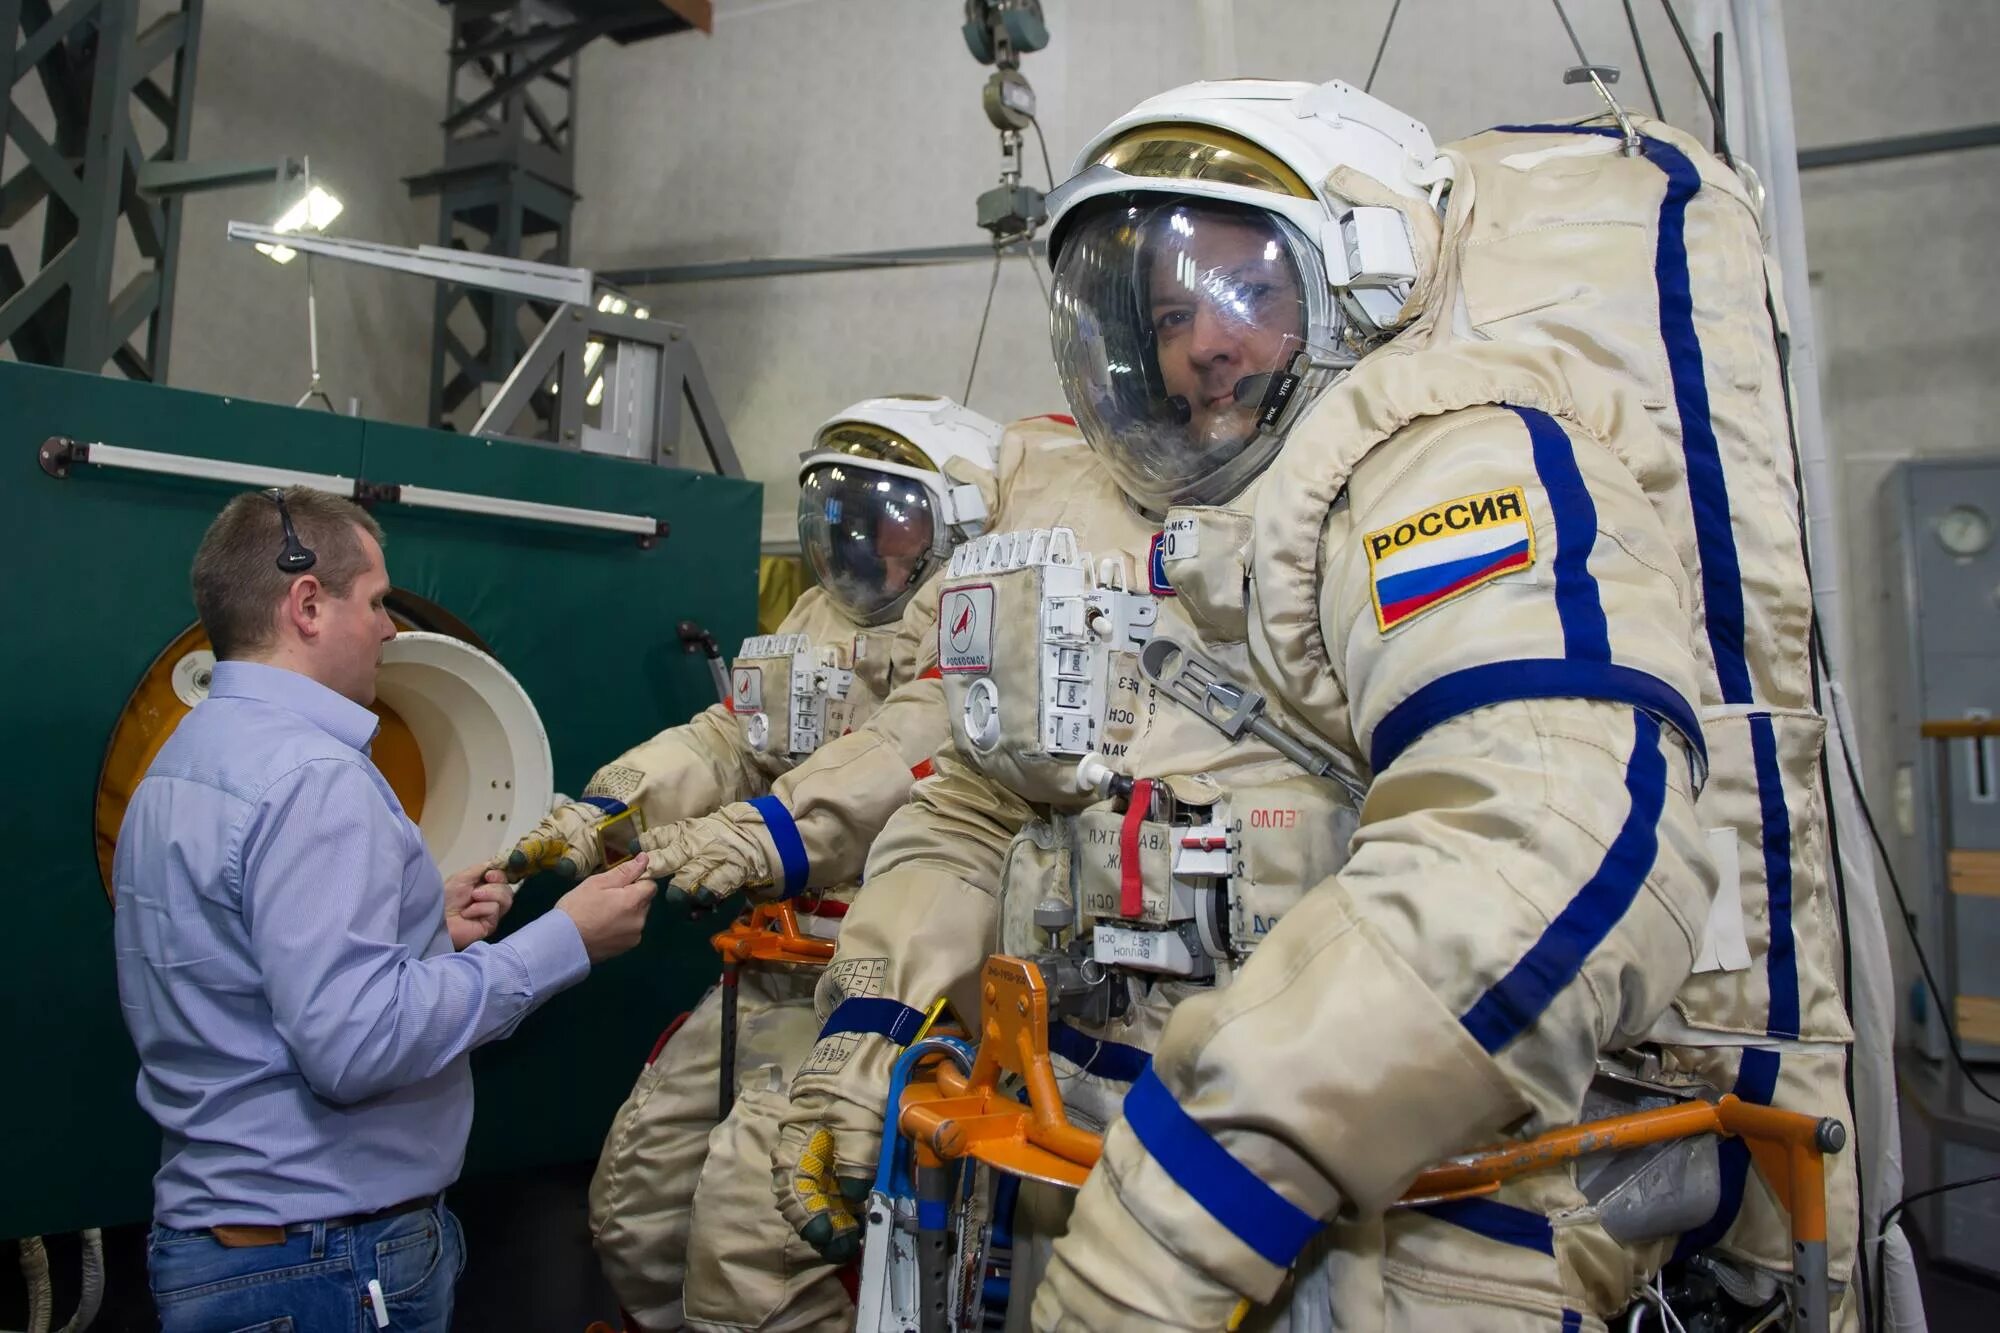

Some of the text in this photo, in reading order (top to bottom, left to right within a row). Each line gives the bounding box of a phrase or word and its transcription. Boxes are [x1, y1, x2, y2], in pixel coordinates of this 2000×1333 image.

[1278, 378, 1293, 396] УТЕЧ
[1372, 493, 1522, 560] РОССИЯ
[946, 656, 986, 665] РОСКОСМОС
